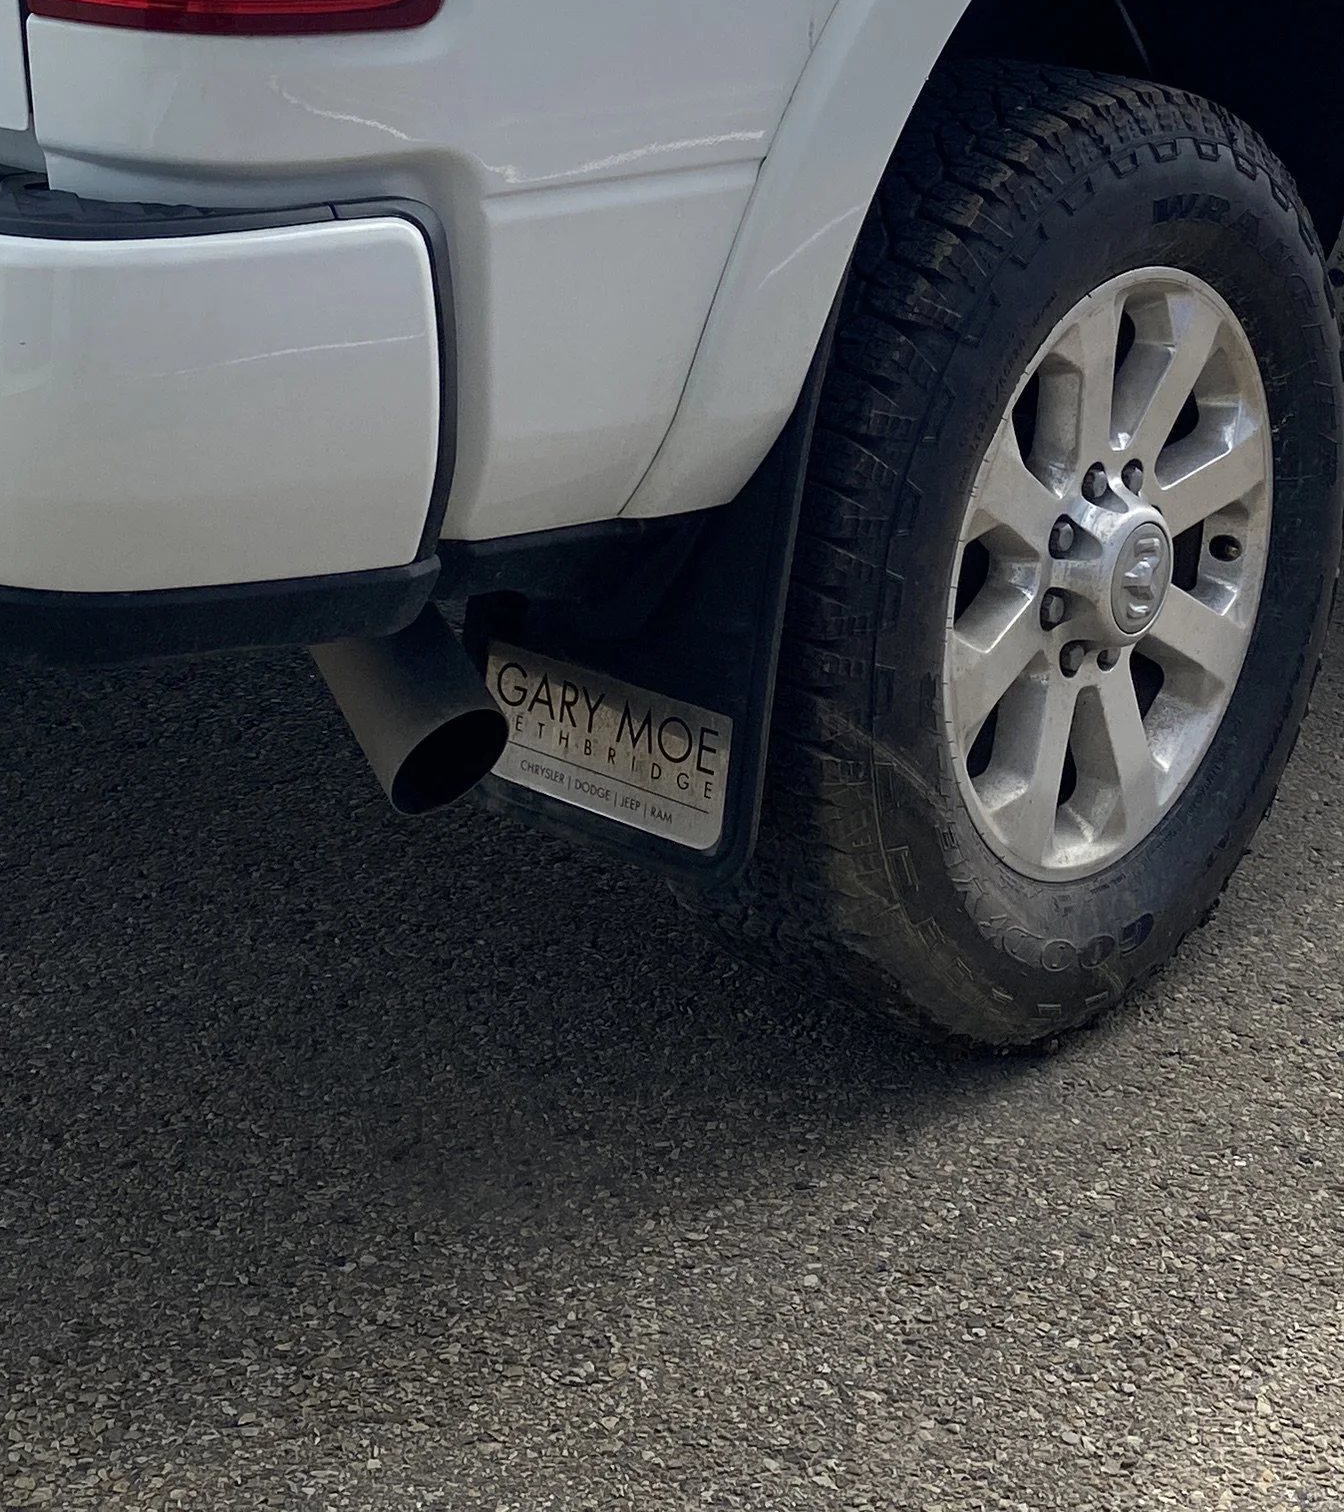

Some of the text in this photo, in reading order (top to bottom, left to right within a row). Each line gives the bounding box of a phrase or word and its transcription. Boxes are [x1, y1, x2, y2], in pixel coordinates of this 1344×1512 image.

[497, 662, 719, 776] GARY MOE
[515, 715, 713, 800] ETHBRIDGE
[520, 759, 673, 825] CHRYSLER DODGE JEEP RAM
